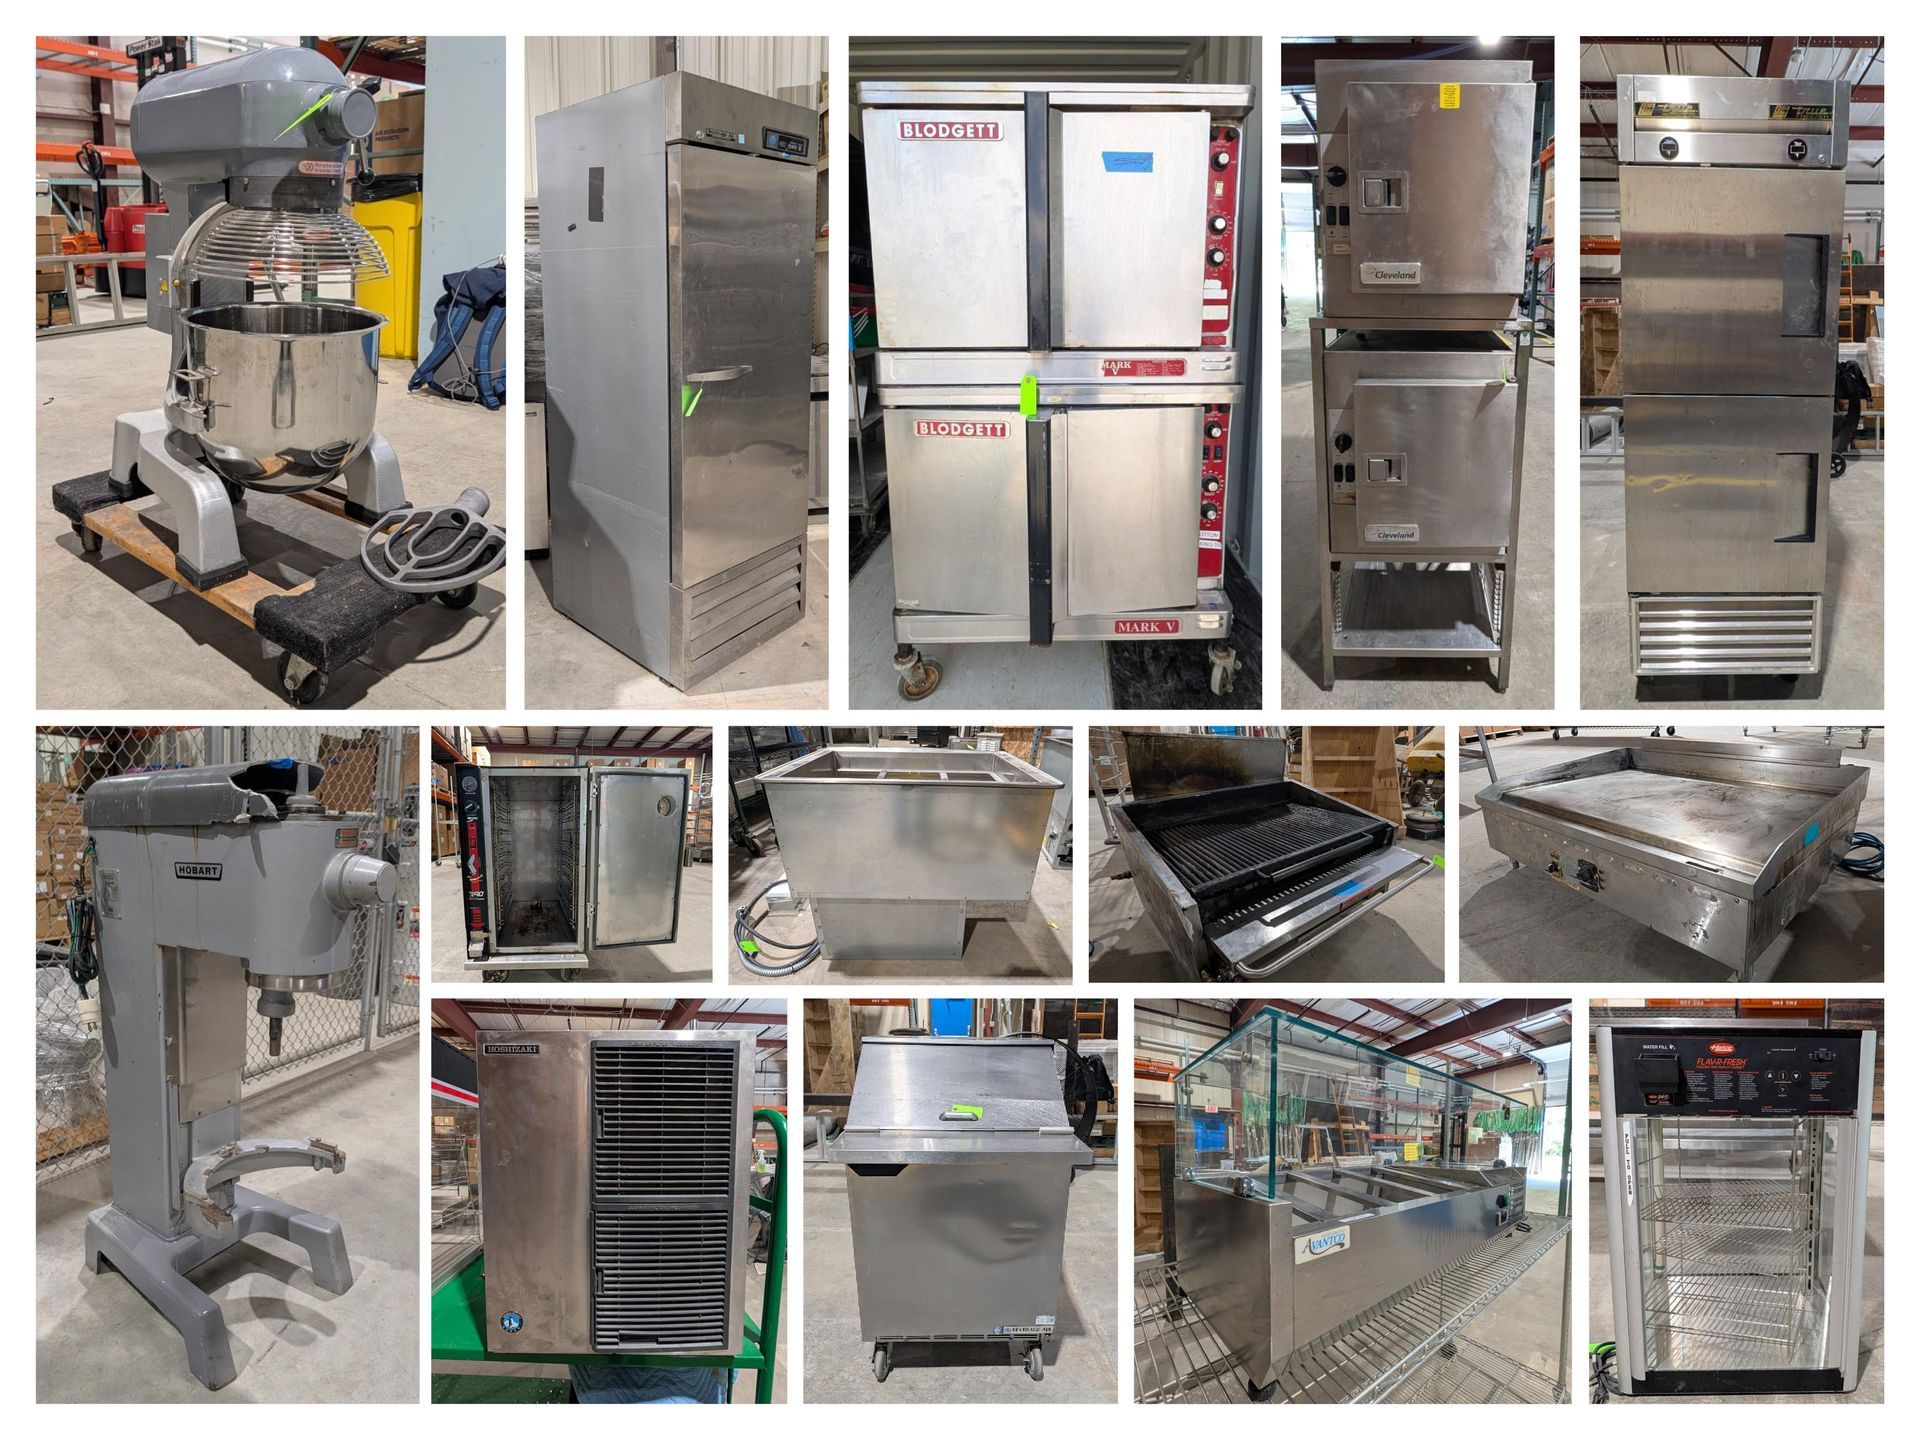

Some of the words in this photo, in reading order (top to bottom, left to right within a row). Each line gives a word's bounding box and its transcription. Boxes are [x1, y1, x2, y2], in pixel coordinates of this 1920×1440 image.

[903, 123, 995, 138] BLODGETT
[1375, 270, 1417, 280] Cleveland
[920, 422, 1003, 436] BLODGETT
[1377, 531, 1415, 539] Cleveland
[1118, 622, 1160, 633] MARK
[1165, 622, 1176, 632] V
[179, 866, 218, 875] HOBART
